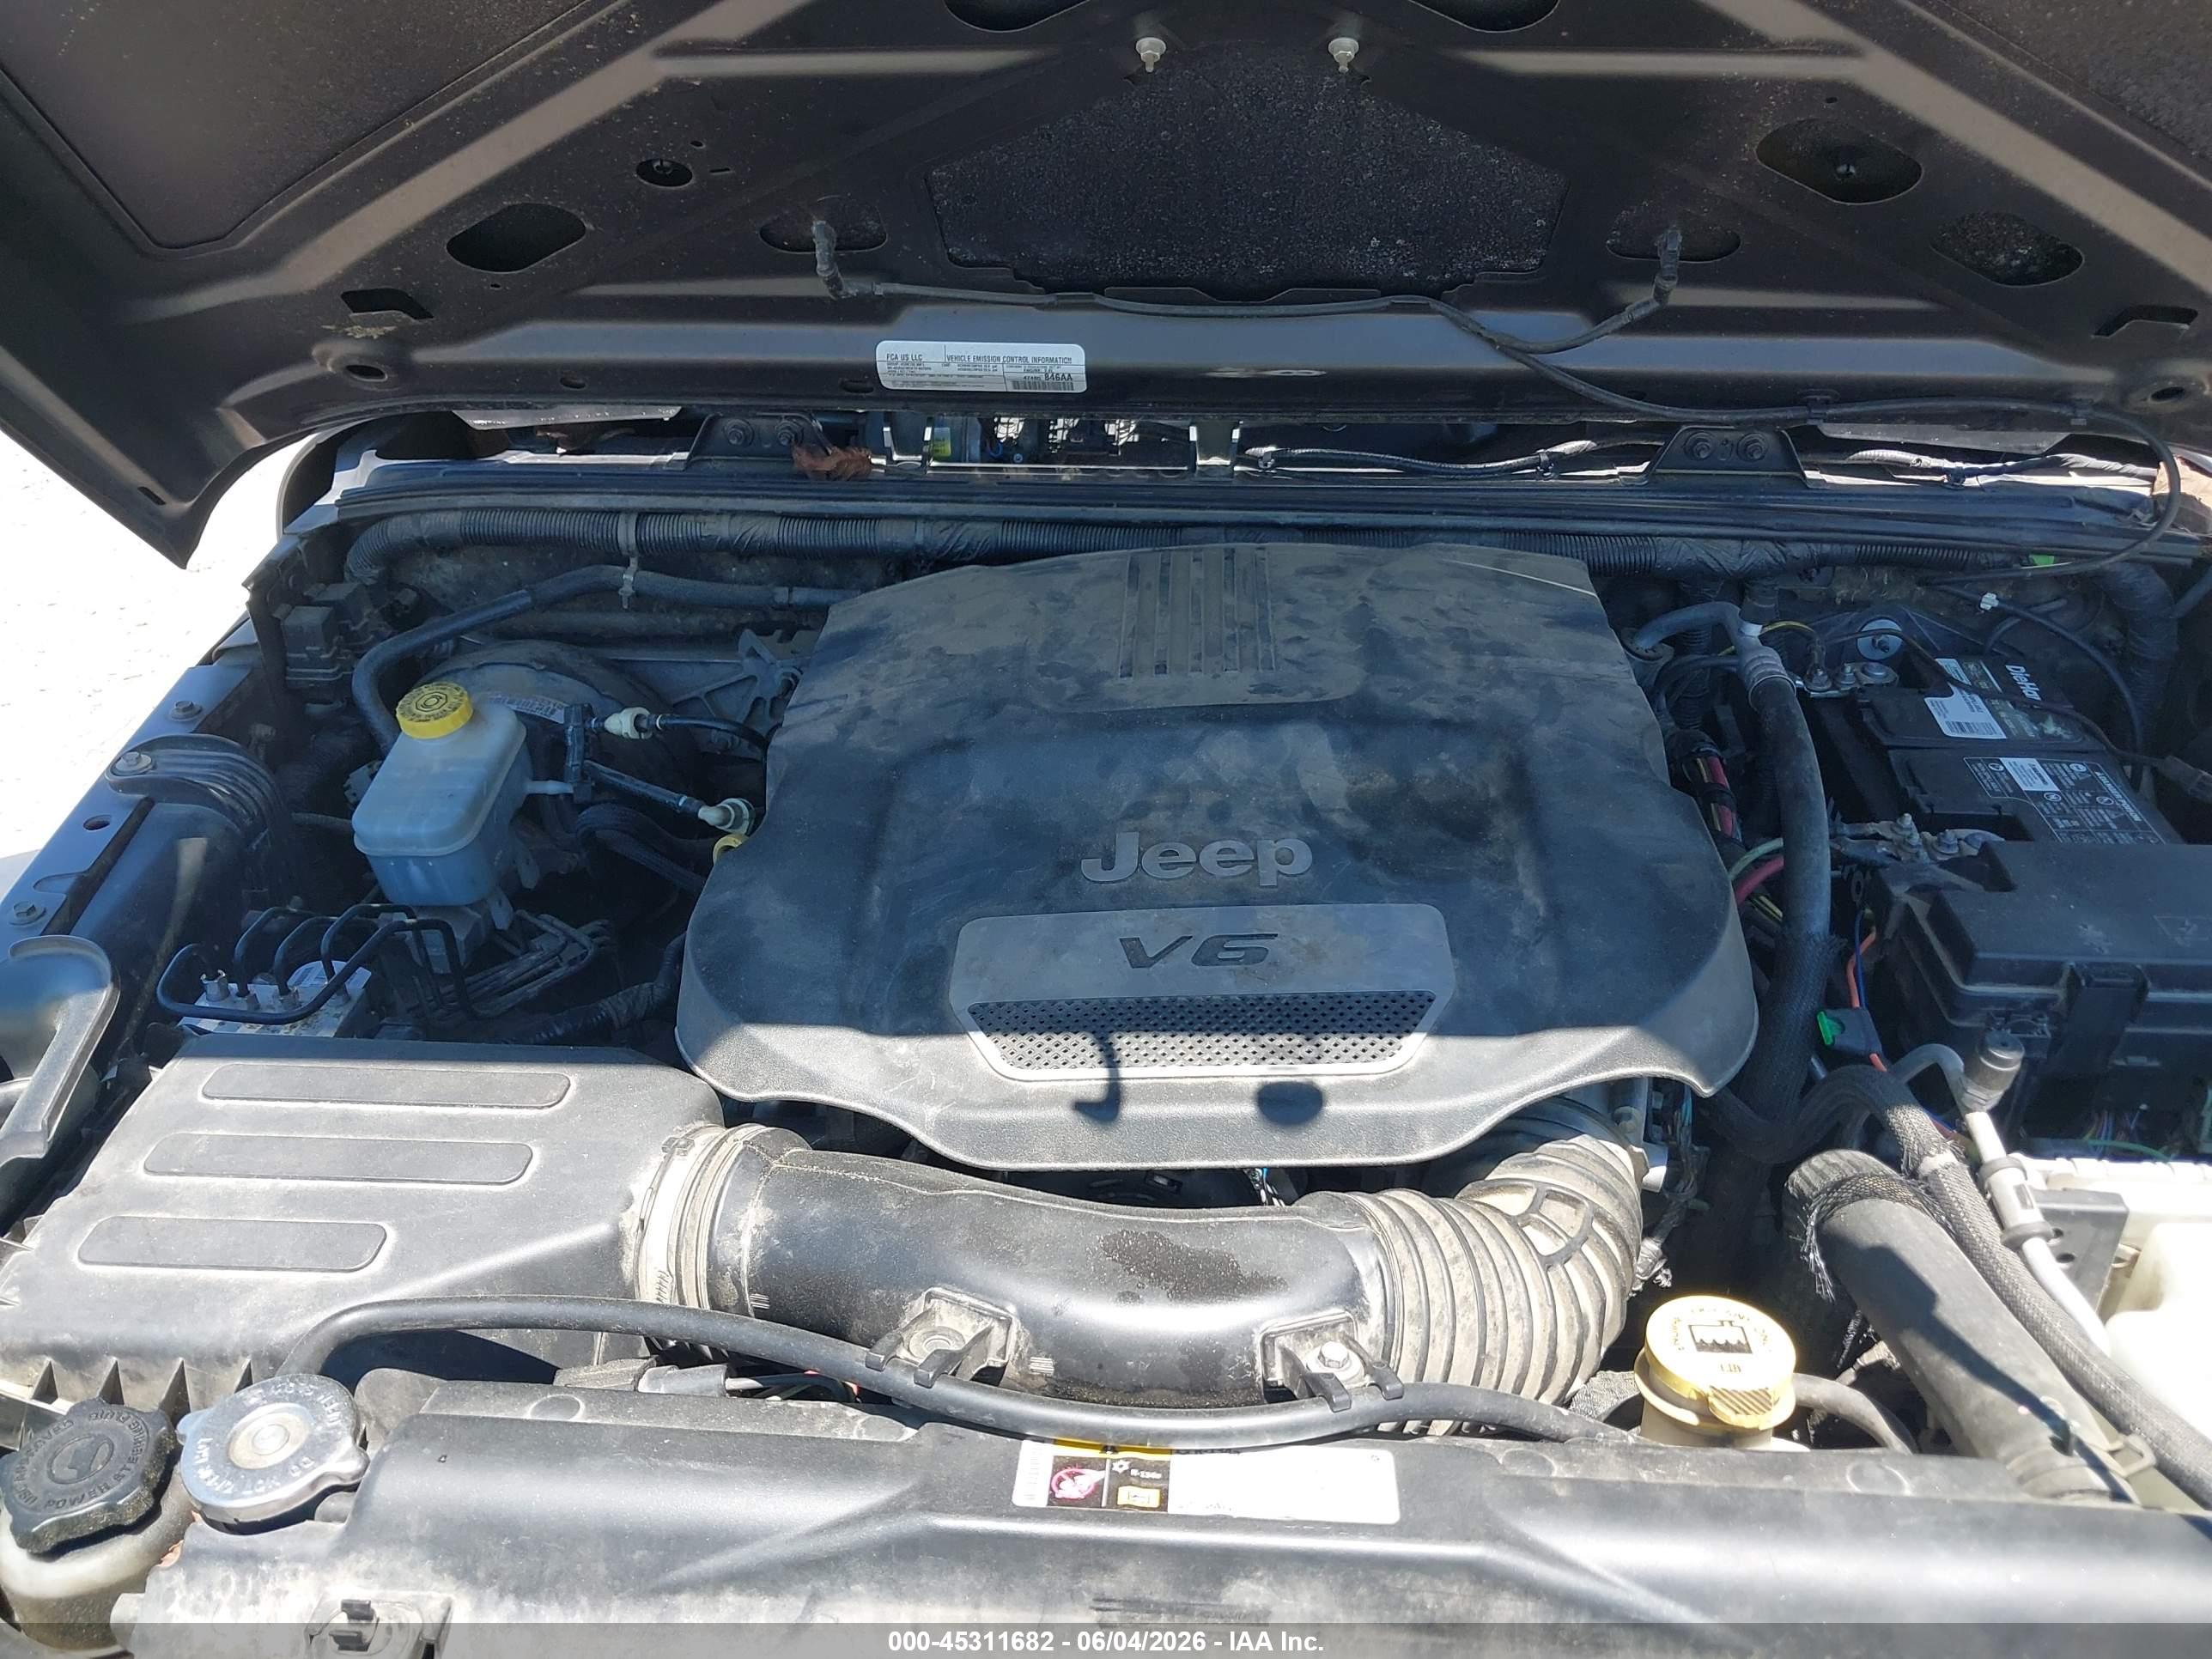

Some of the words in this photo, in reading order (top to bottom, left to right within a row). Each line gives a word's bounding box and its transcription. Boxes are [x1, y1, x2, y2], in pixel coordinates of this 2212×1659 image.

[911, 353, 923, 362] LLC
[1044, 373, 1073, 381] 846AA
[1080, 831, 1313, 887] Jeep
[1119, 933, 1279, 969] V6
[45, 1483, 112, 1510] POWER
[113, 1417, 146, 1483] STEERING
